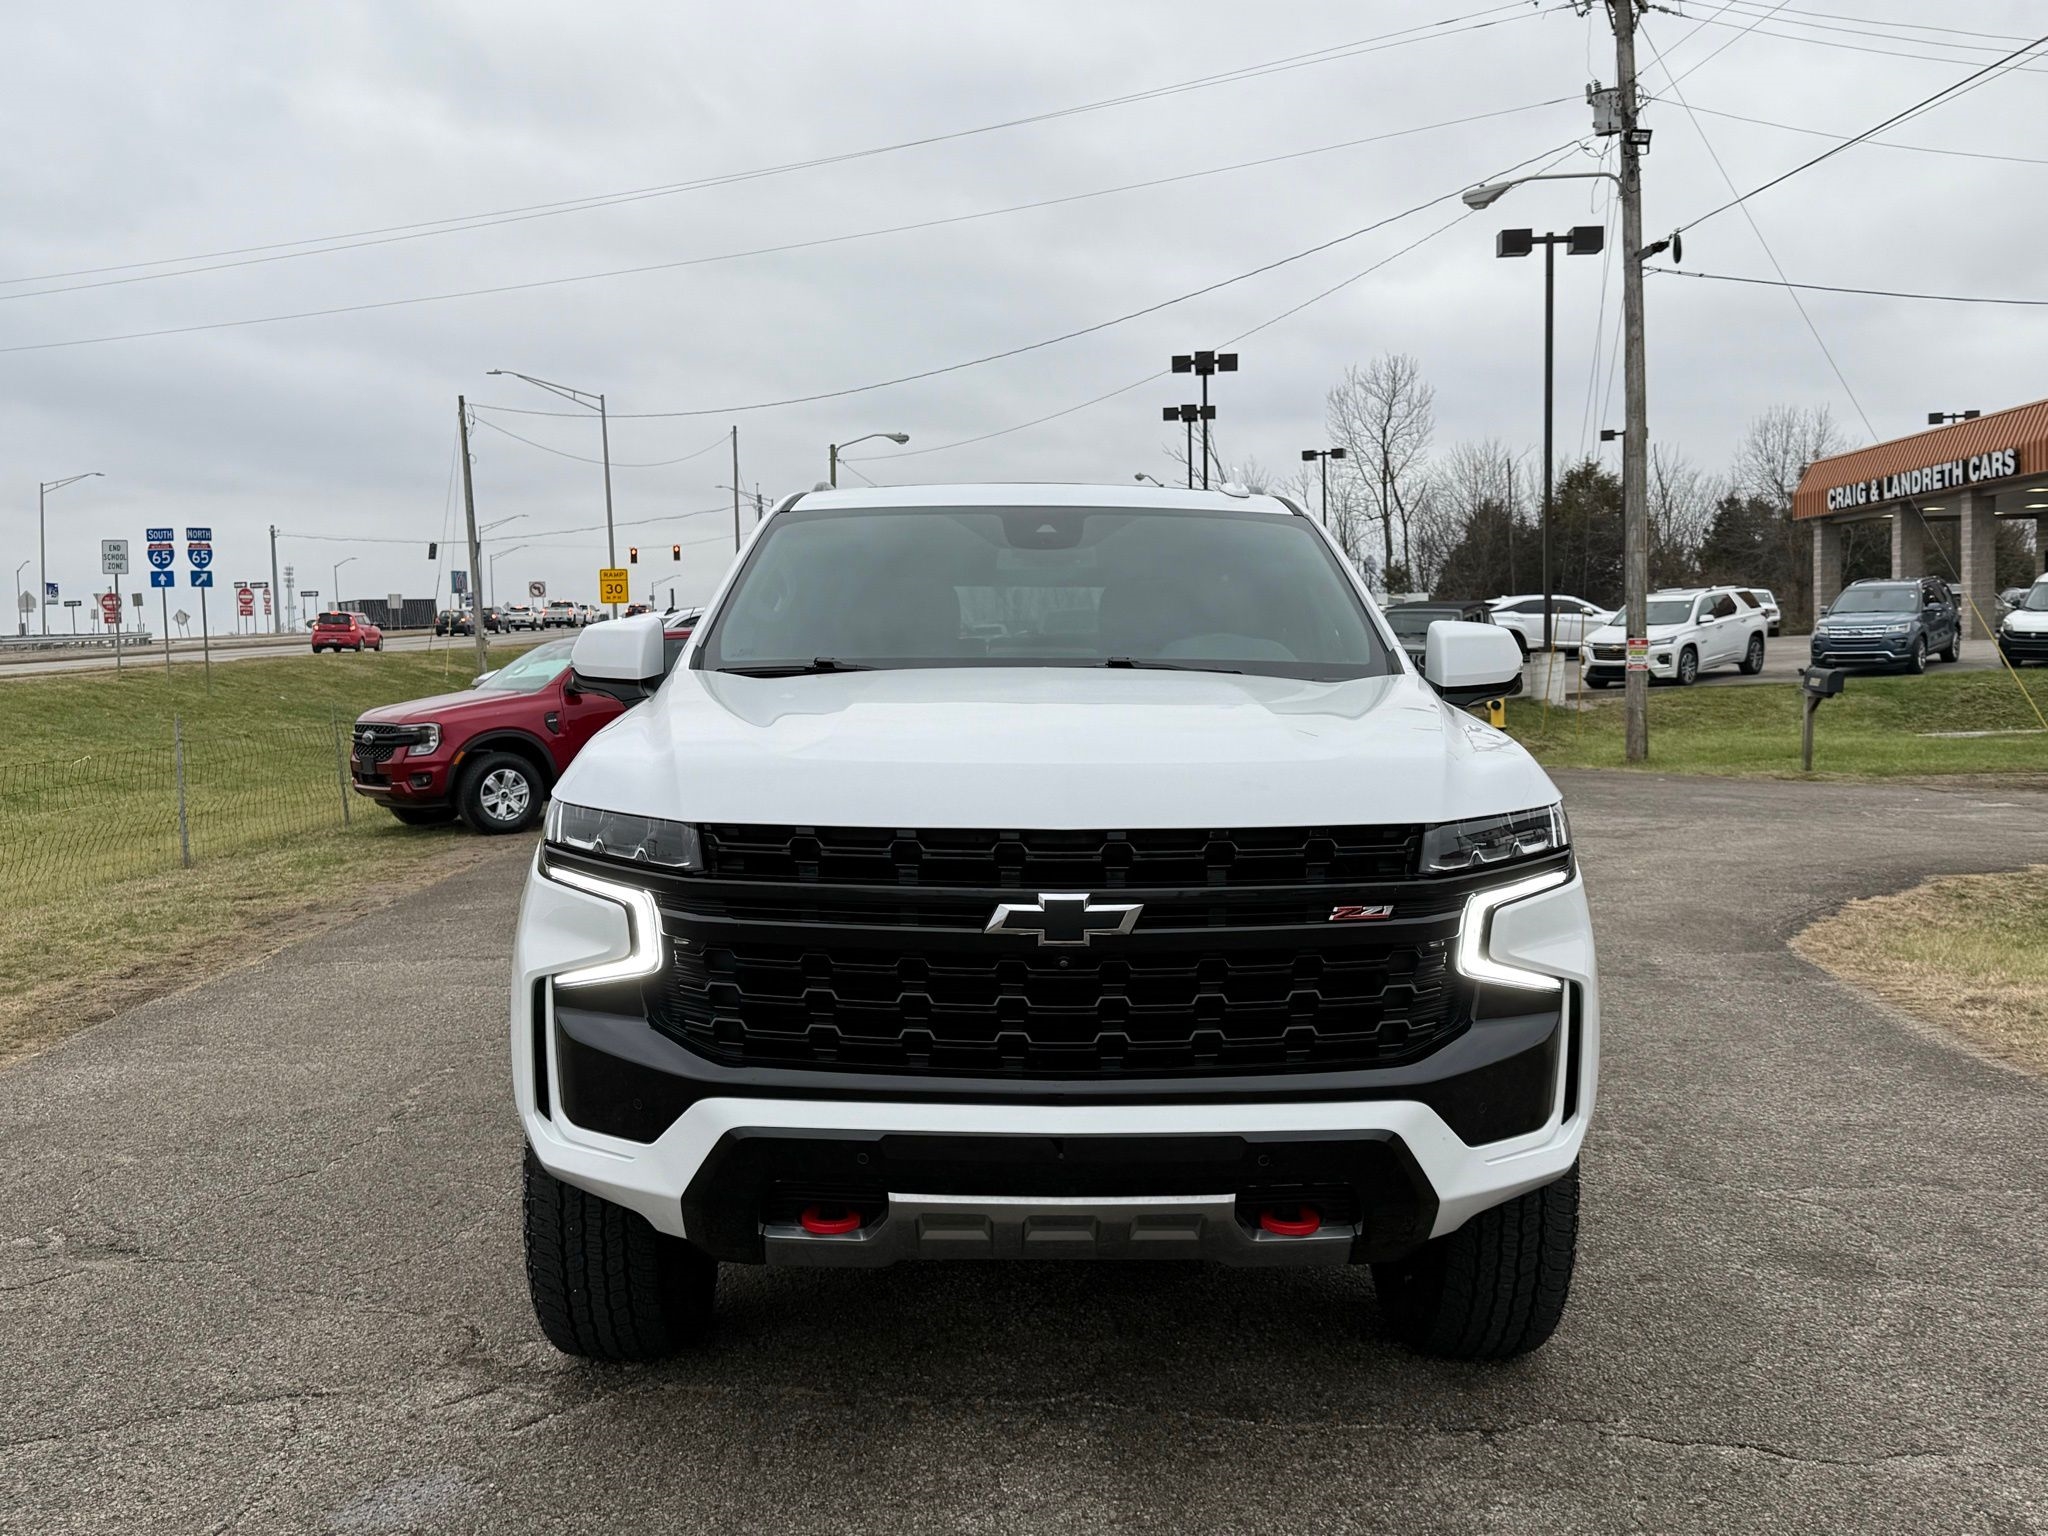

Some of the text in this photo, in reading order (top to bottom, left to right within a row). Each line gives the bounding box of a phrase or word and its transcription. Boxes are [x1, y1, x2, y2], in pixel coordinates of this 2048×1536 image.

[1827, 448, 2016, 511] CRAIG & LANDRETH CARS
[148, 529, 172, 540] SOUTH
[187, 529, 211, 539] NORTH
[108, 544, 121, 552] END
[103, 553, 127, 561] SCHOOL
[152, 551, 171, 565] 65
[192, 550, 209, 564] 65
[107, 562, 123, 570] ZONE
[605, 583, 623, 594] 30
